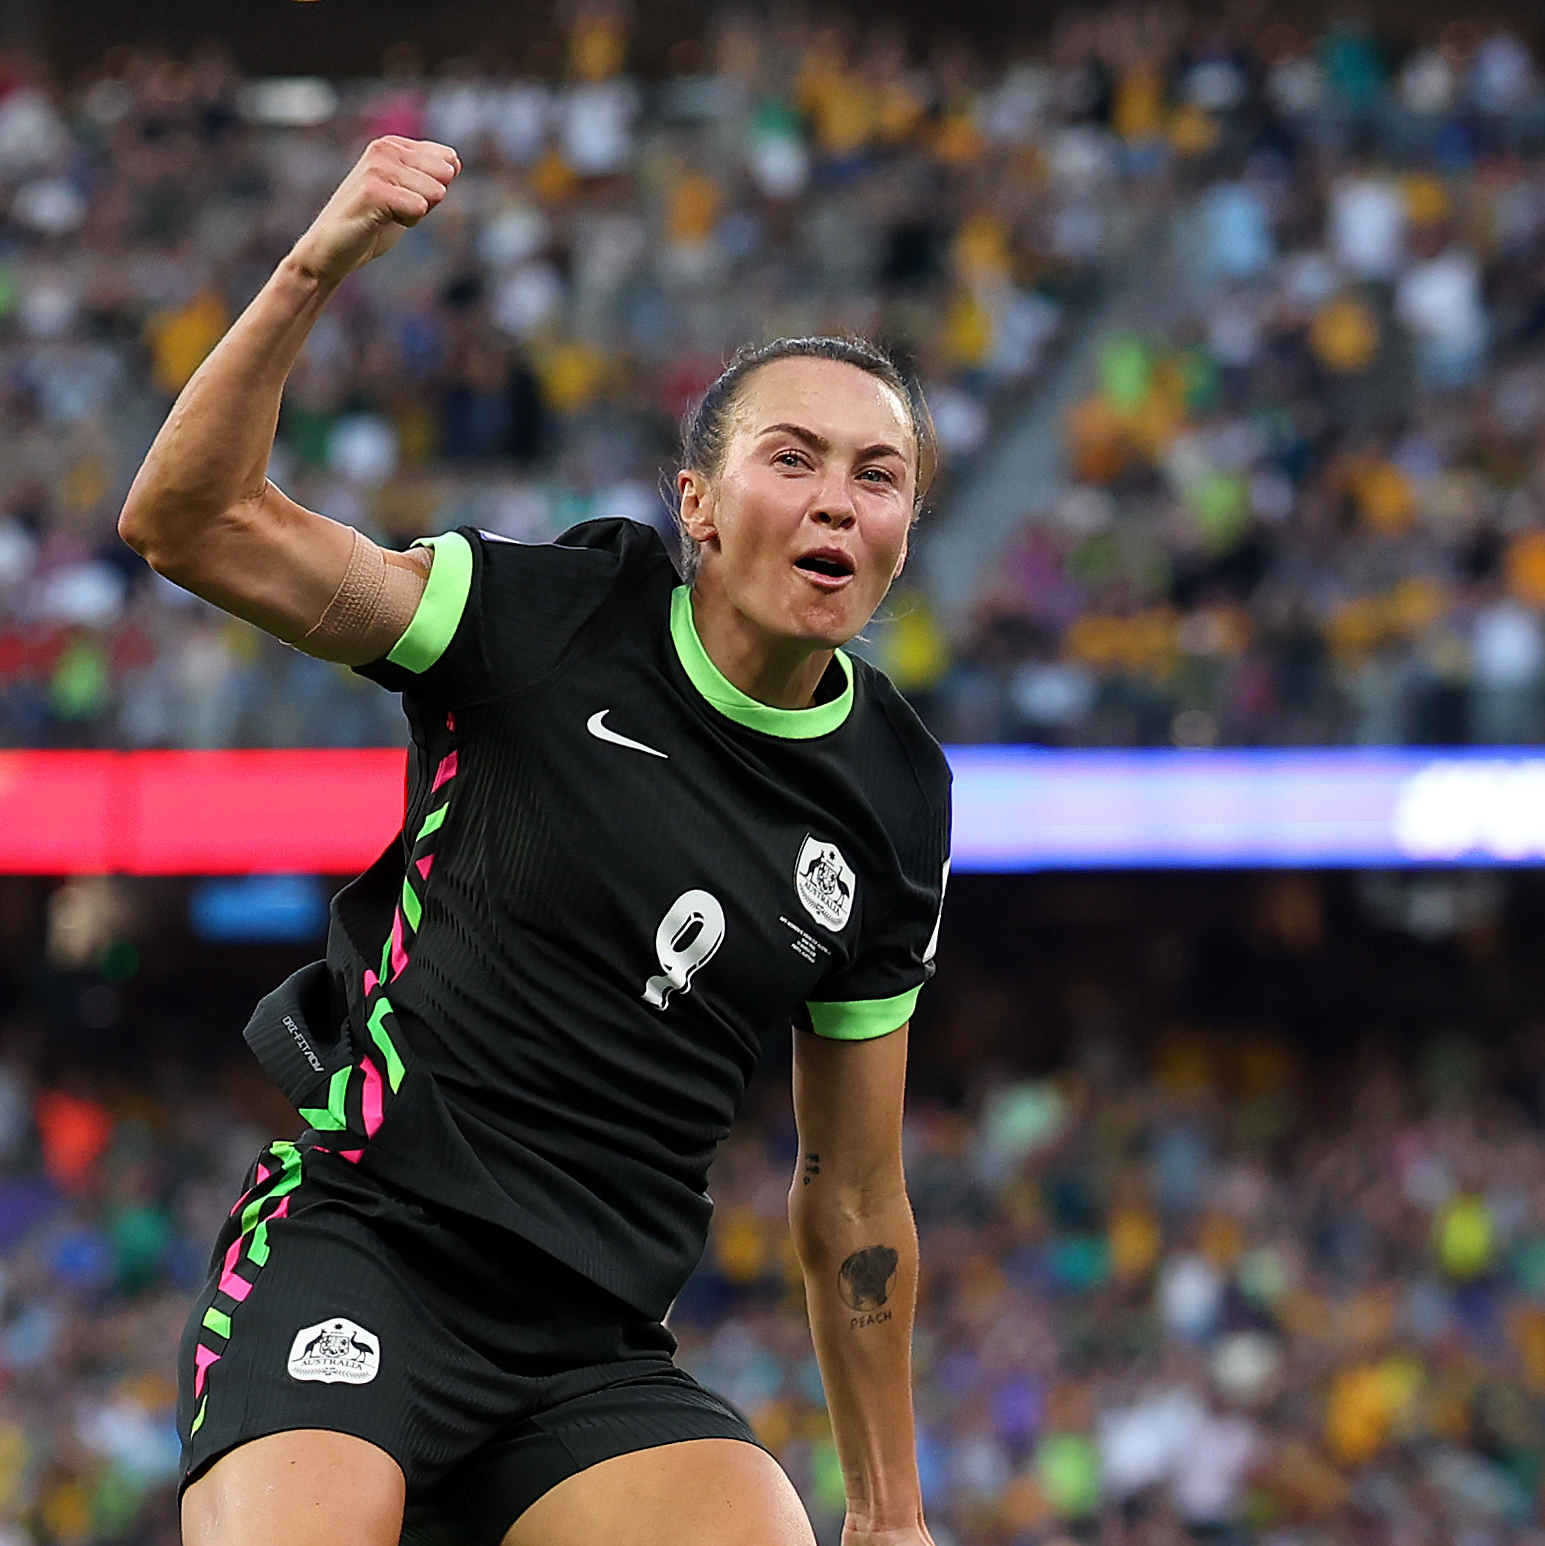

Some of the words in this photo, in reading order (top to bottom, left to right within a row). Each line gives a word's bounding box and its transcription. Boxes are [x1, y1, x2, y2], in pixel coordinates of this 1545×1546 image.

[640, 888, 726, 1012] 9
[849, 1309, 893, 1331] PEACH
[300, 1357, 363, 1371] AUSTRALIA
